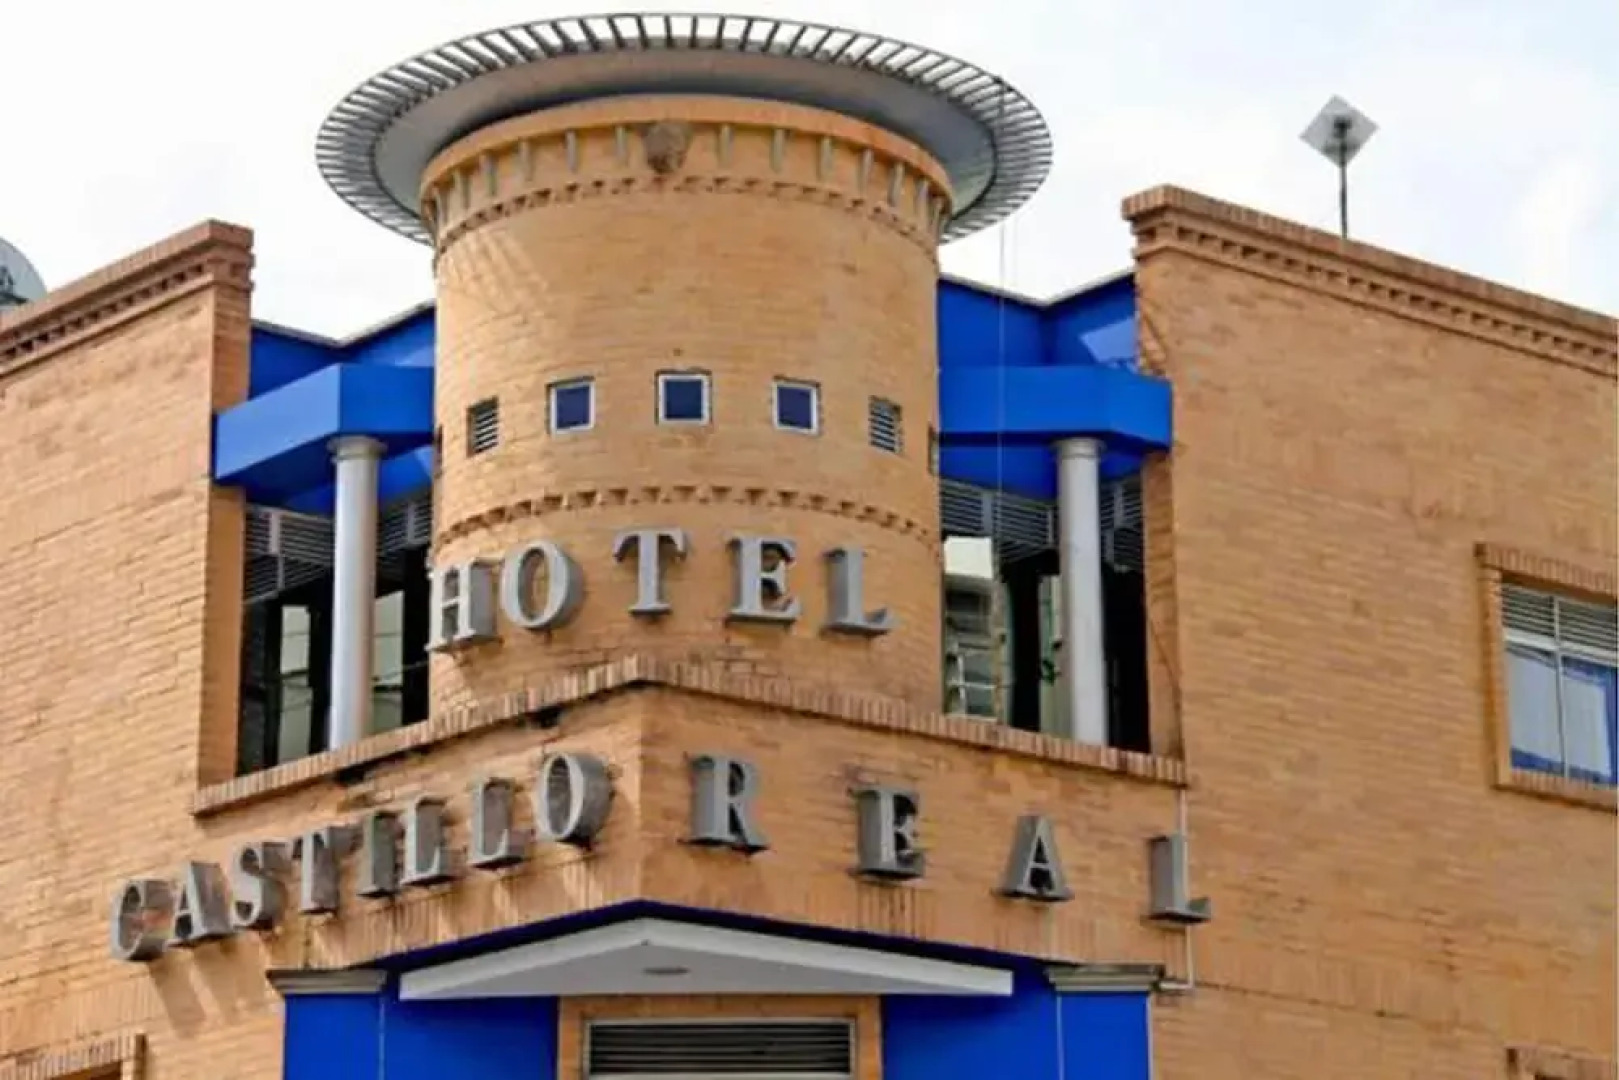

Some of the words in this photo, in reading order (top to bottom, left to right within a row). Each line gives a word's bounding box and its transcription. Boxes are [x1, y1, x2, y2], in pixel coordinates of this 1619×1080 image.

[425, 526, 894, 651] HOTEL
[110, 751, 614, 961] CASTILLO
[682, 754, 1211, 923] REAL
